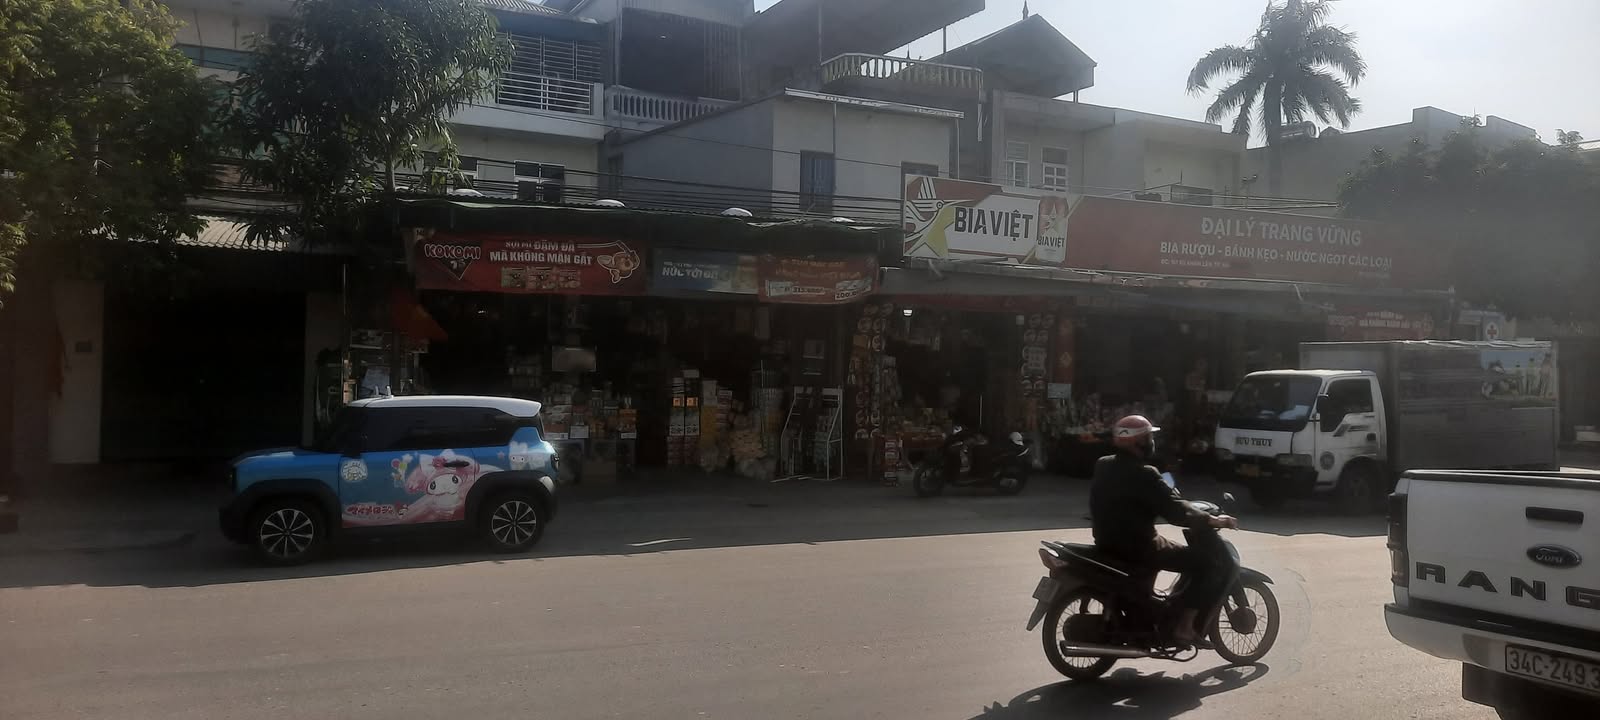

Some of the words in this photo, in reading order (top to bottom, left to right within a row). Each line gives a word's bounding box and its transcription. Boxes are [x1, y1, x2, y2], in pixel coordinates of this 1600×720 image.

[955, 207, 987, 235] BIA
[990, 209, 1034, 242] VIỆT
[1201, 216, 1231, 240] ĐẠI
[1235, 216, 1256, 237] LÝ
[1260, 221, 1313, 243] TRANG
[1316, 224, 1362, 247] VỮNG
[424, 244, 482, 260] KOKOMI
[510, 249, 546, 263] KHÔNG
[1160, 242, 1179, 254] BIA
[1181, 243, 1216, 258] RƯỢU
[1225, 244, 1256, 258] BÁNH
[1257, 248, 1279, 262] KẸO
[1287, 249, 1317, 263] NƯỚC
[1319, 253, 1347, 269] NGỌT
[1348, 254, 1370, 268] CÁC
[1371, 258, 1393, 272] LOẠI
[1416, 562, 1600, 611] RANG
